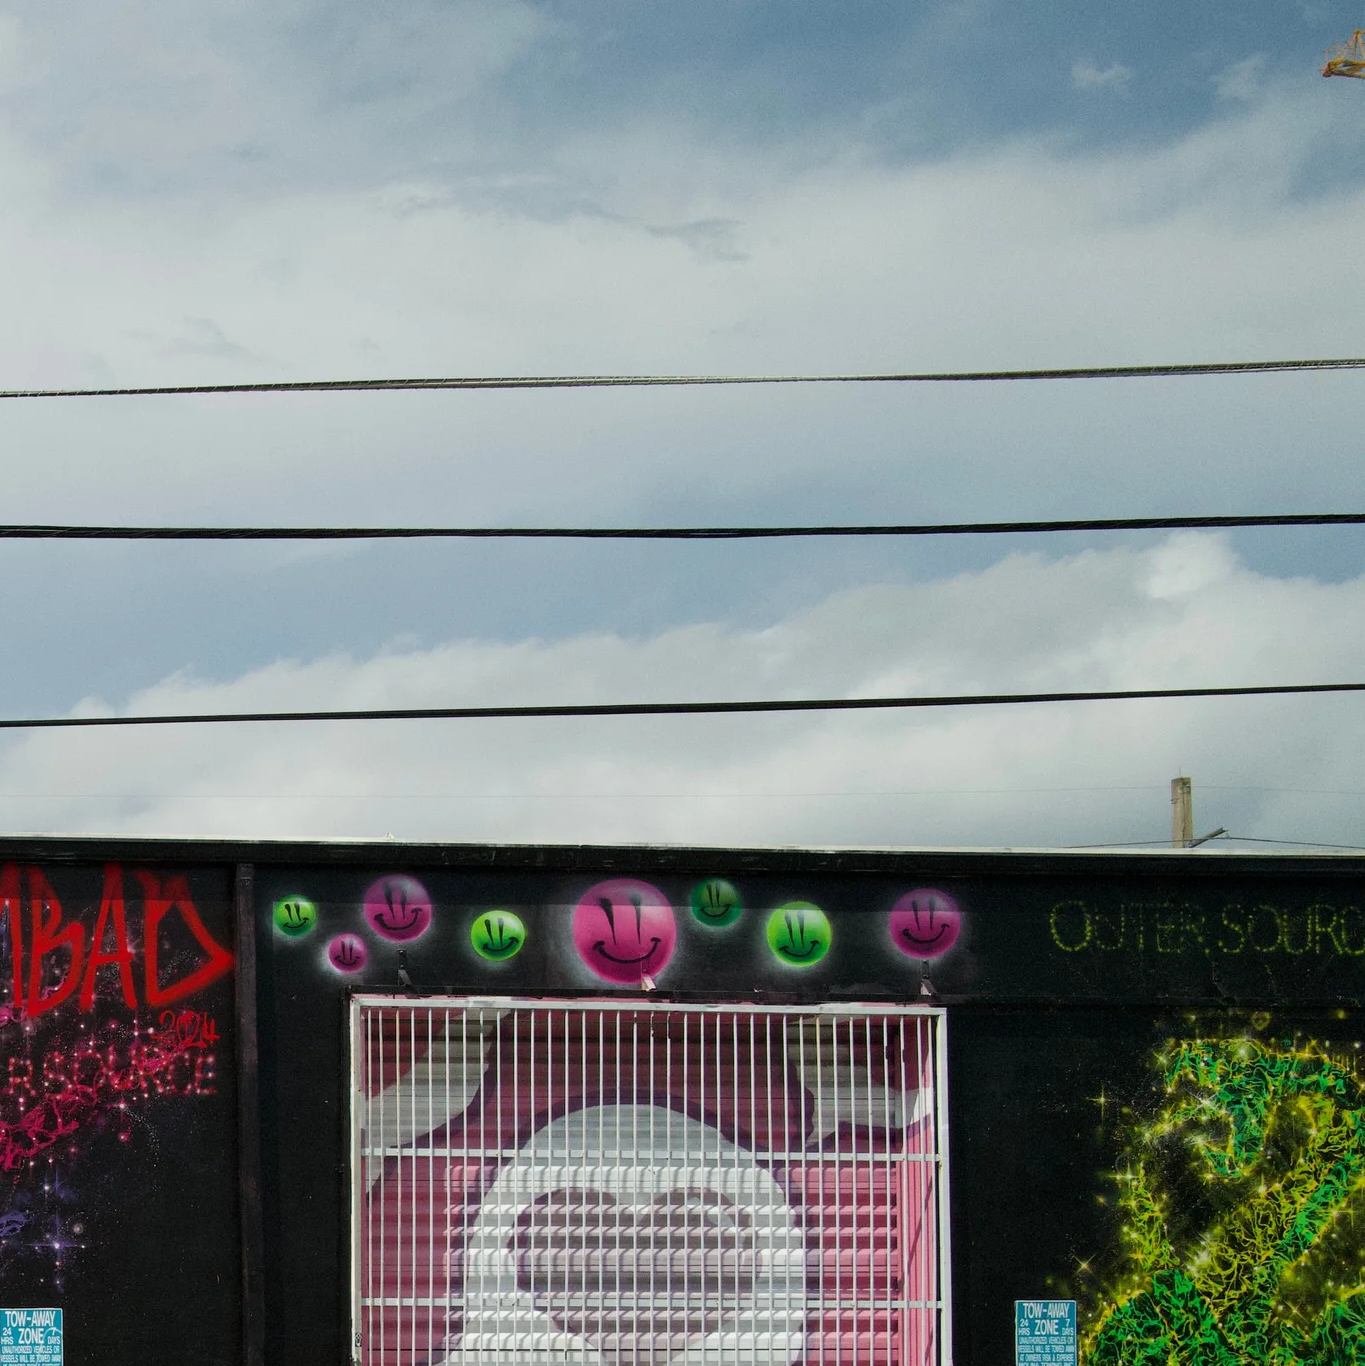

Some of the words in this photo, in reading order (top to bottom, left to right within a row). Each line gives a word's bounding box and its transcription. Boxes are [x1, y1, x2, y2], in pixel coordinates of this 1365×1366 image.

[1048, 899, 1210, 955] OUTER
[155, 1010, 222, 1048] 2024
[42, 1043, 218, 1099] SOURCE
[1023, 1303, 1069, 1318] TOW-AWAY
[5, 1311, 55, 1327] TOW-AWAY
[1020, 1319, 1028, 1327] 24
[1035, 1320, 1059, 1335] ZONE
[18, 1328, 44, 1344] ZONE
[48, 1336, 60, 1344] DAYS
